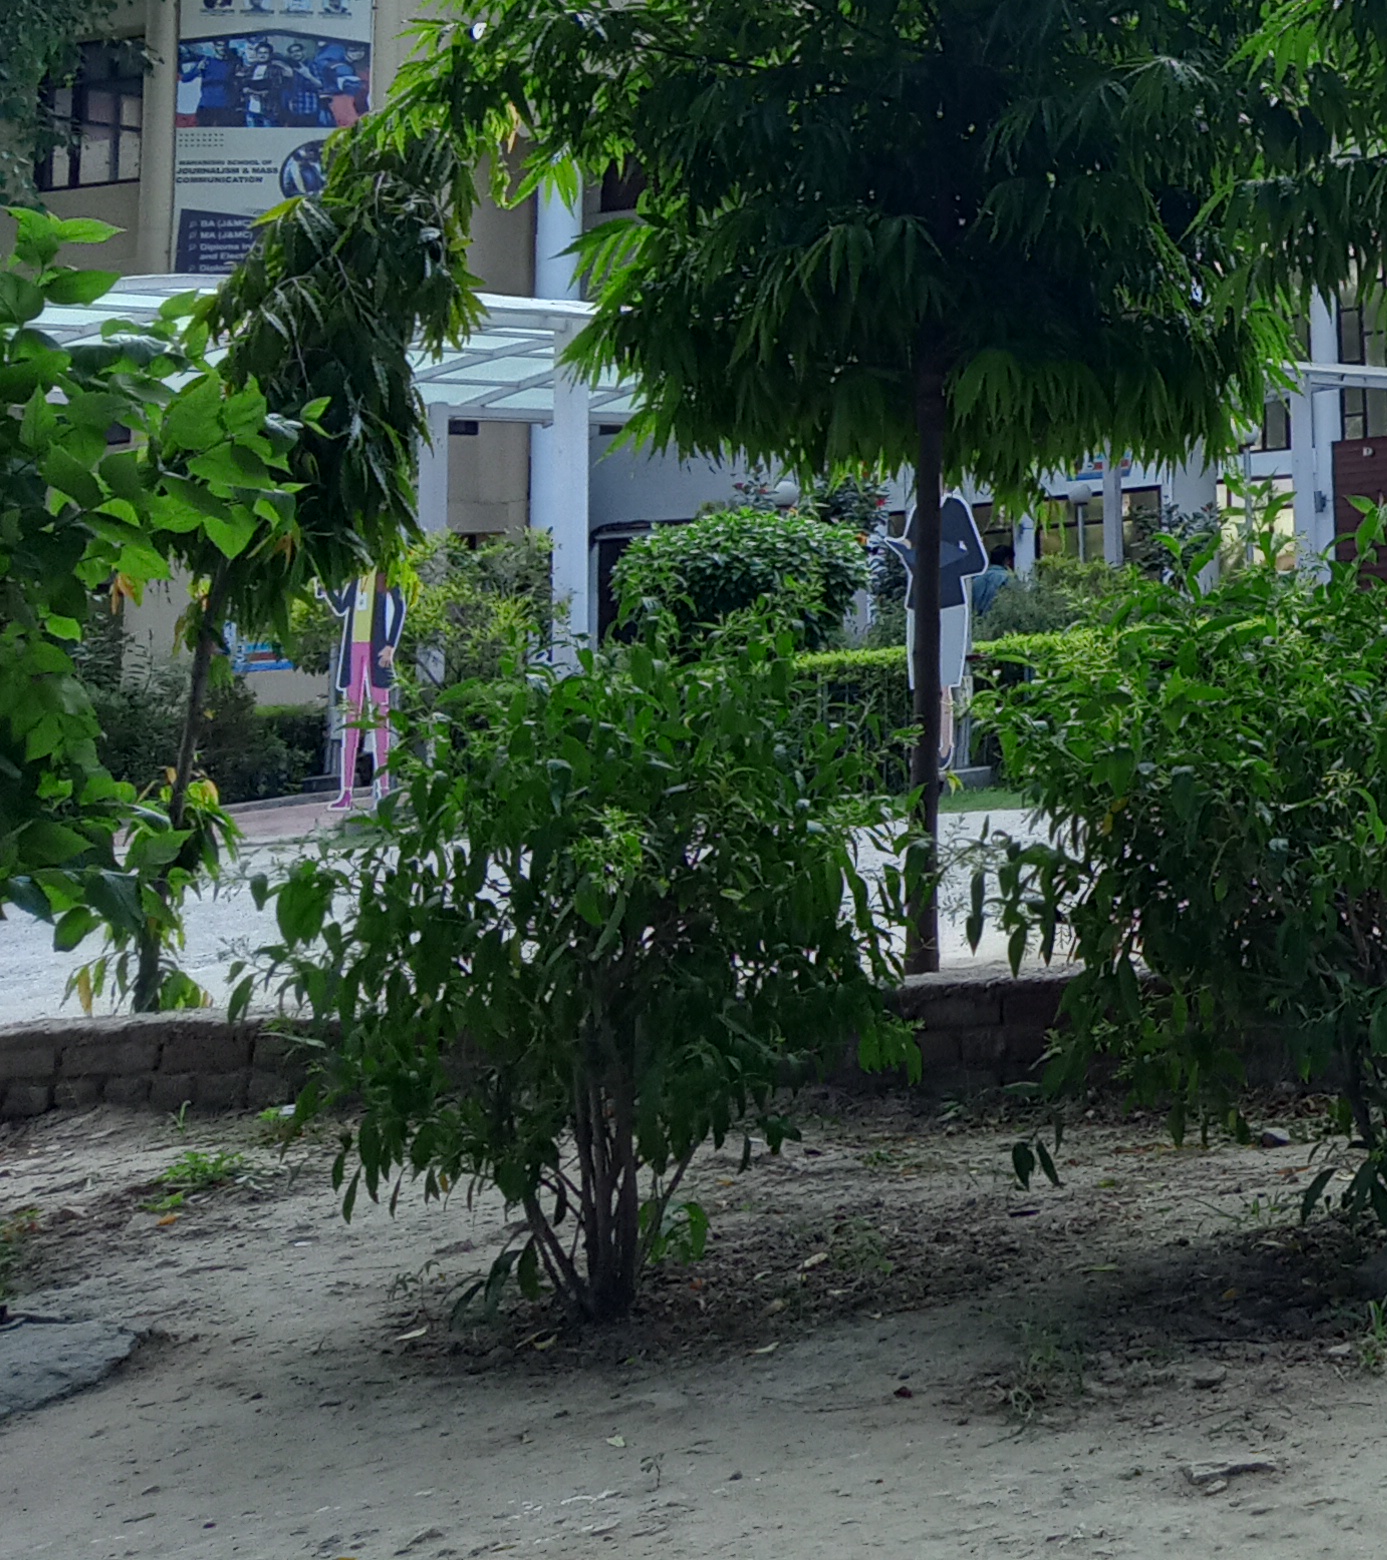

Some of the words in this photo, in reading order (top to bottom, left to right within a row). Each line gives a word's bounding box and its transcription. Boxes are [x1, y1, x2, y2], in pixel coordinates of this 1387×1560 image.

[176, 176, 264, 184] COMMUNICATION
[200, 220, 215, 228] BA
[200, 244, 240, 252] Diploma
